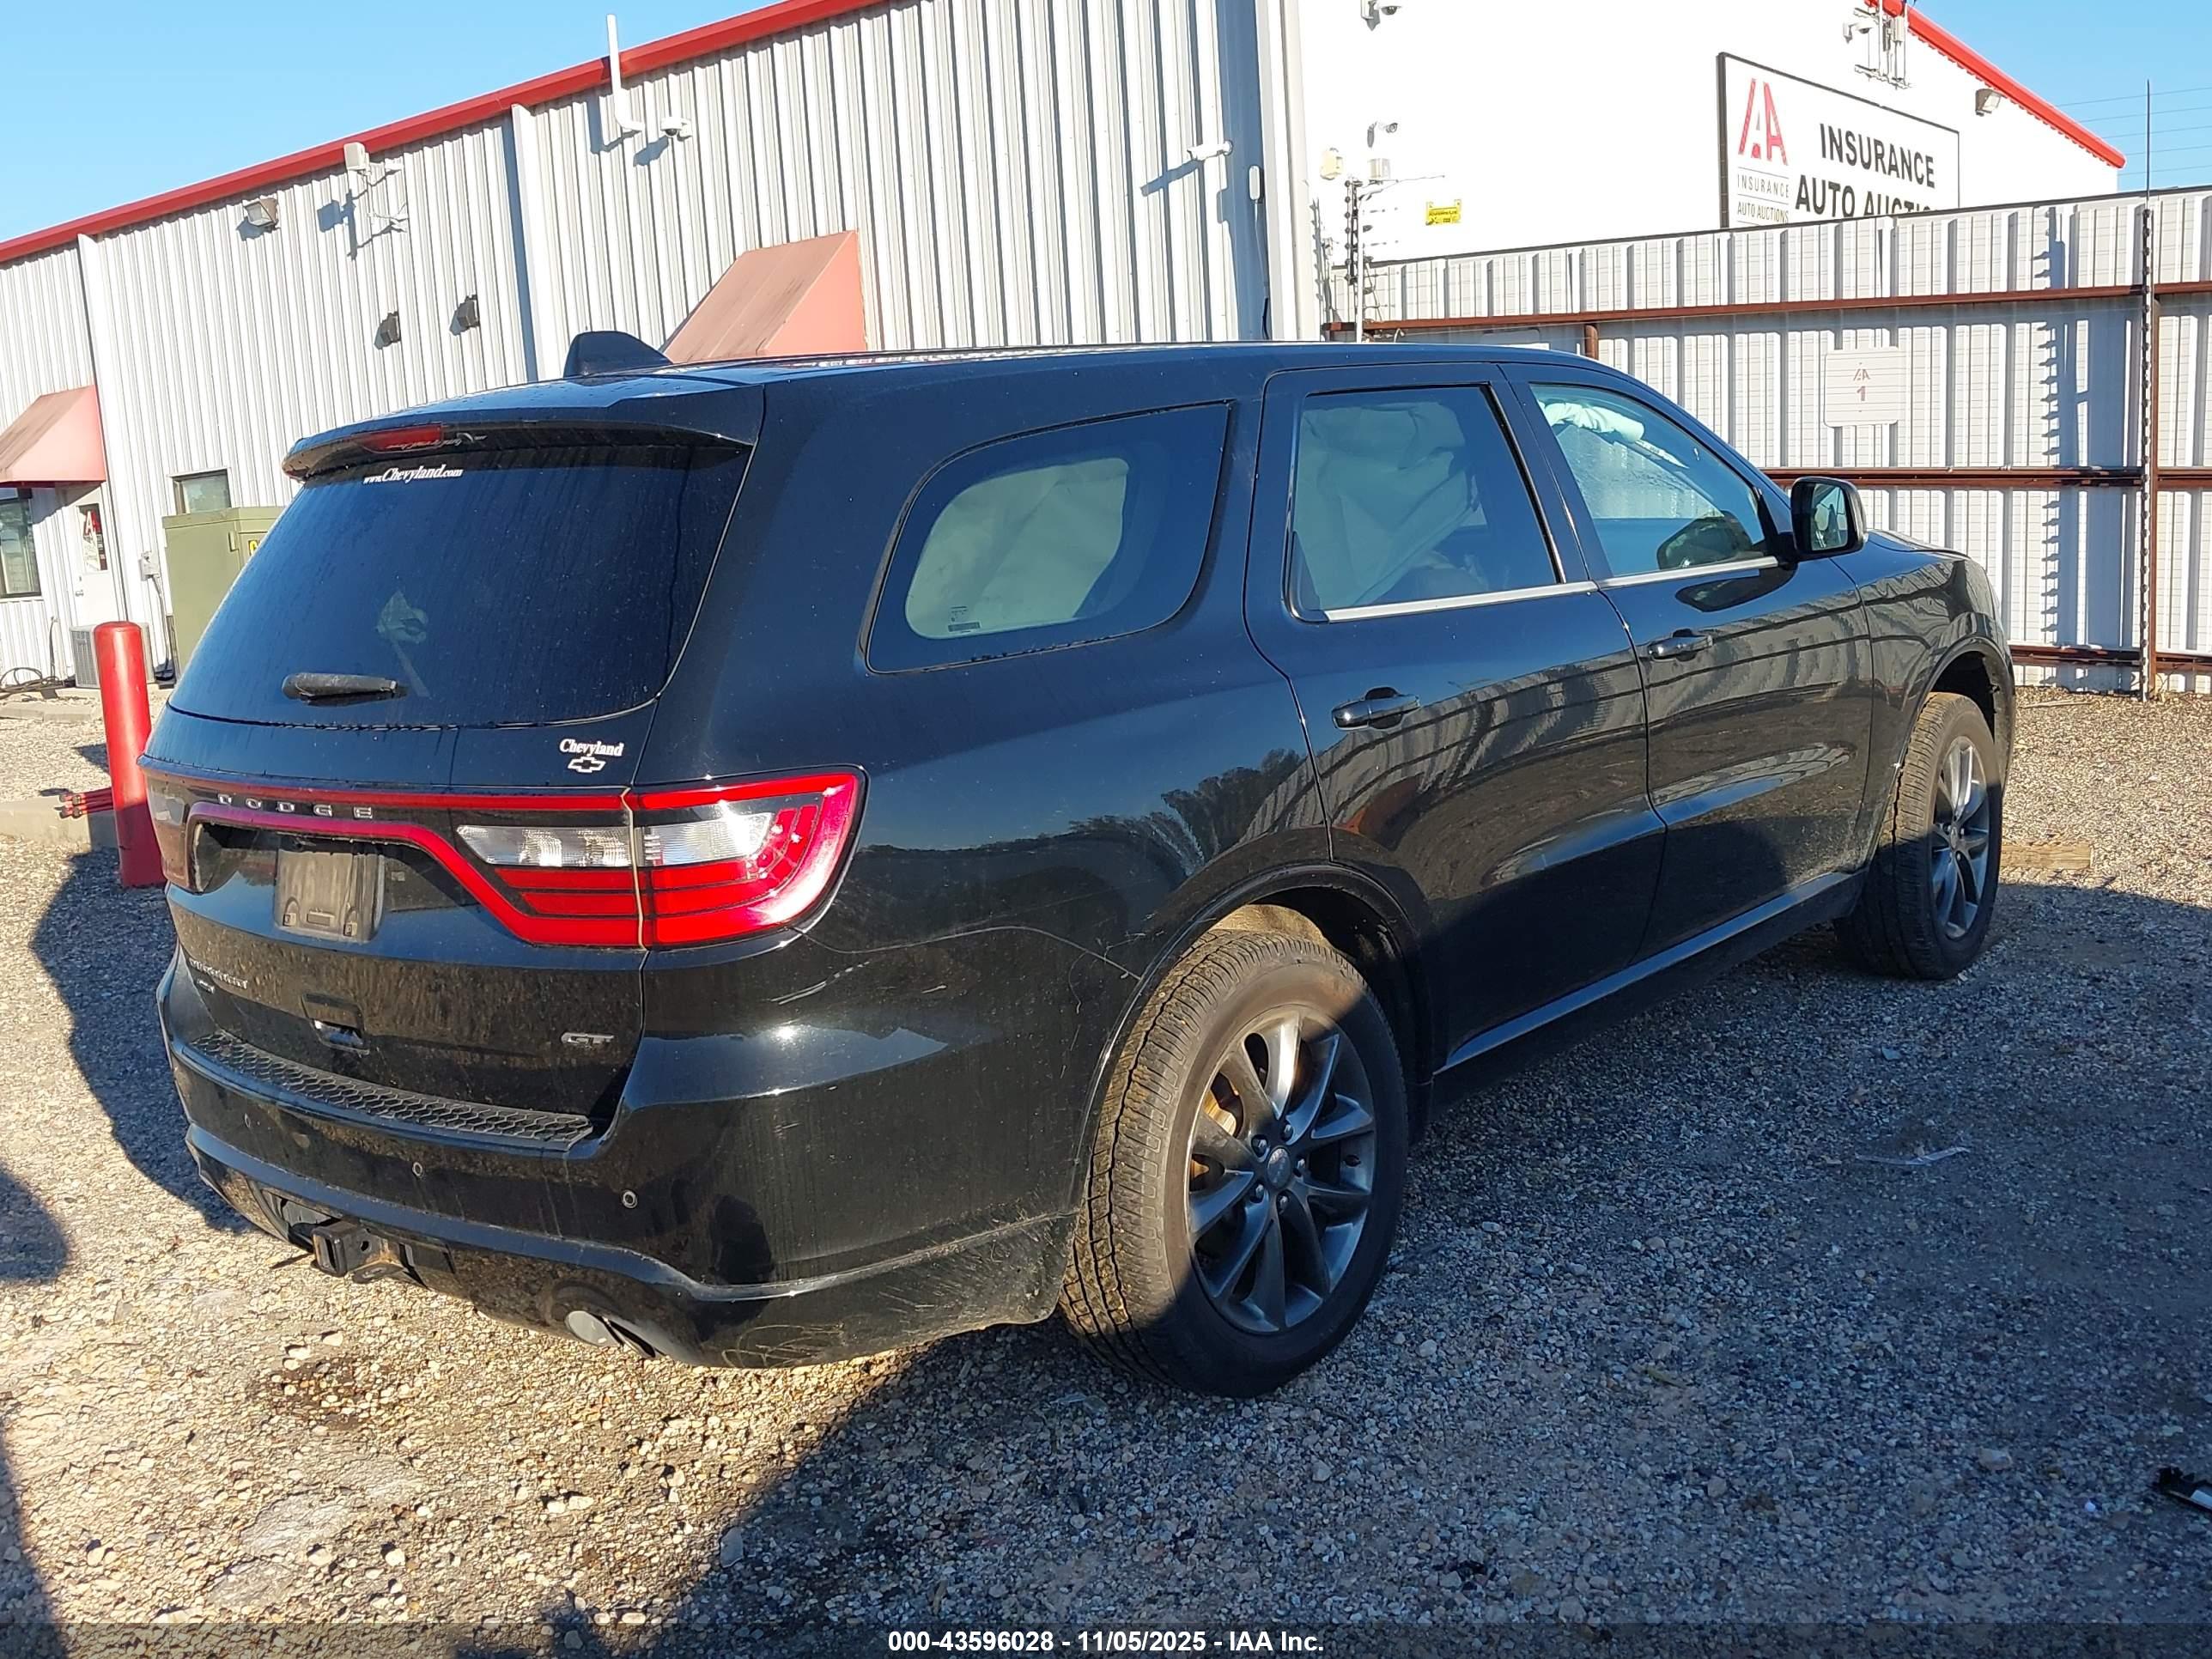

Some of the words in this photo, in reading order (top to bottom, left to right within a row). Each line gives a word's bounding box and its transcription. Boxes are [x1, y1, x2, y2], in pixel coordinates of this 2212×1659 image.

[1819, 123, 1936, 189] INSURANCE
[1737, 173, 1790, 198] INSURANCE
[1795, 174, 1856, 217] AUTO
[1737, 201, 1756, 217] AUTO
[1757, 204, 1790, 224] AUCTIONS
[1856, 386, 1866, 402] 1
[362, 463, 464, 484] www.Chevyland.com
[559, 738, 624, 757] Chevyland
[217, 793, 374, 819] DODGE
[560, 1031, 615, 1045] GT
